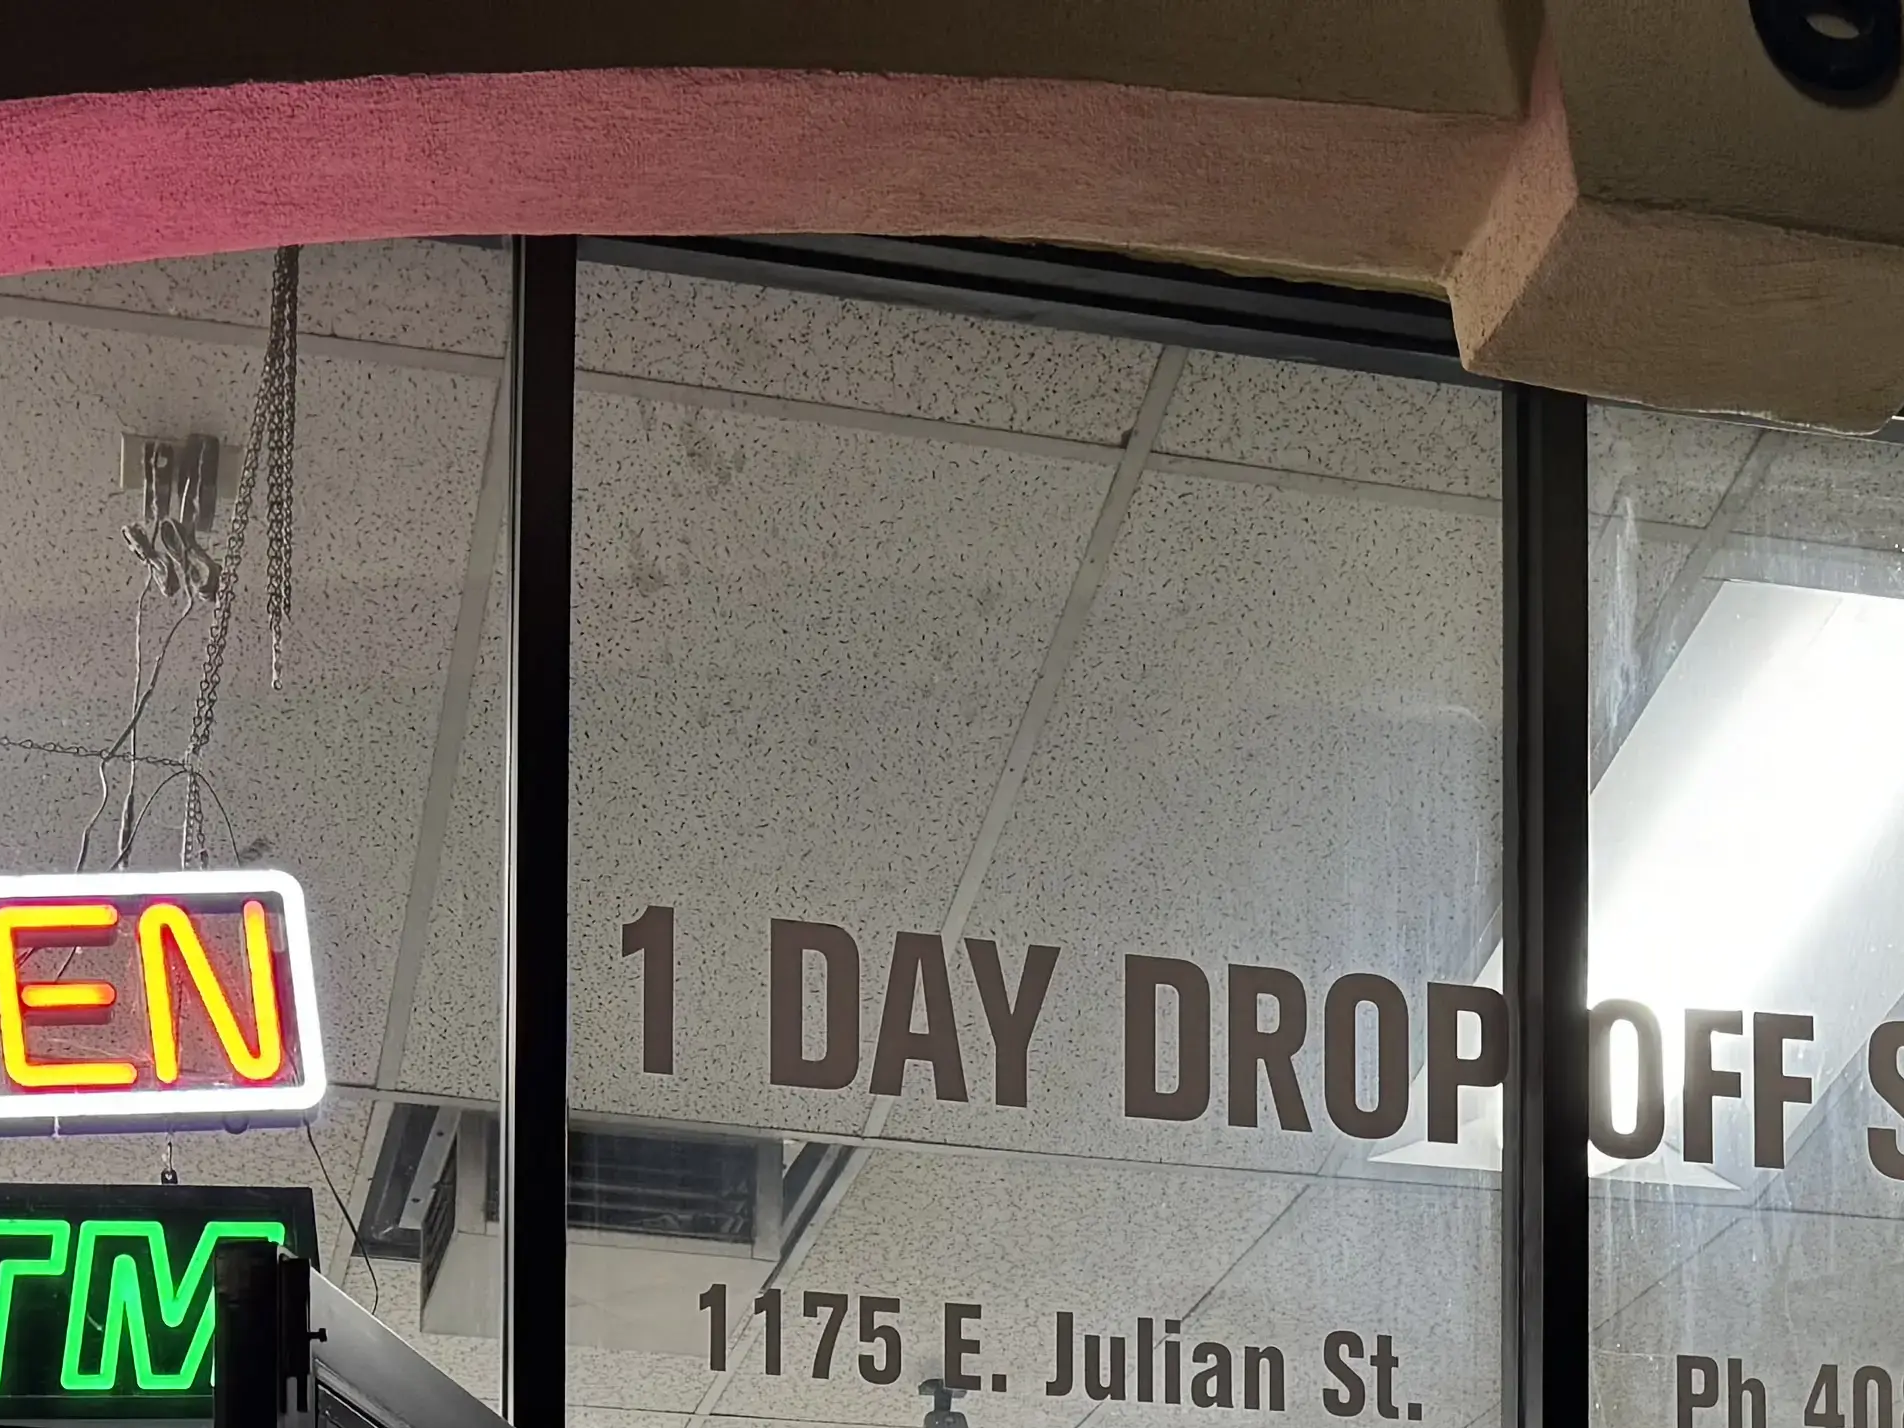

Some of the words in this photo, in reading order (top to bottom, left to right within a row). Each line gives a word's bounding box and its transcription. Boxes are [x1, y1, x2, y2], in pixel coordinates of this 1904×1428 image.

[621, 904, 675, 1076] 1
[770, 917, 1061, 1109] DAY
[1124, 953, 1511, 1145] DROP
[1587, 997, 1815, 1170] OFF
[698, 1282, 902, 1388] 1175
[944, 1301, 1009, 1393] E.
[1045, 1309, 1286, 1413] Julian
[1322, 1329, 1423, 1421] St.
